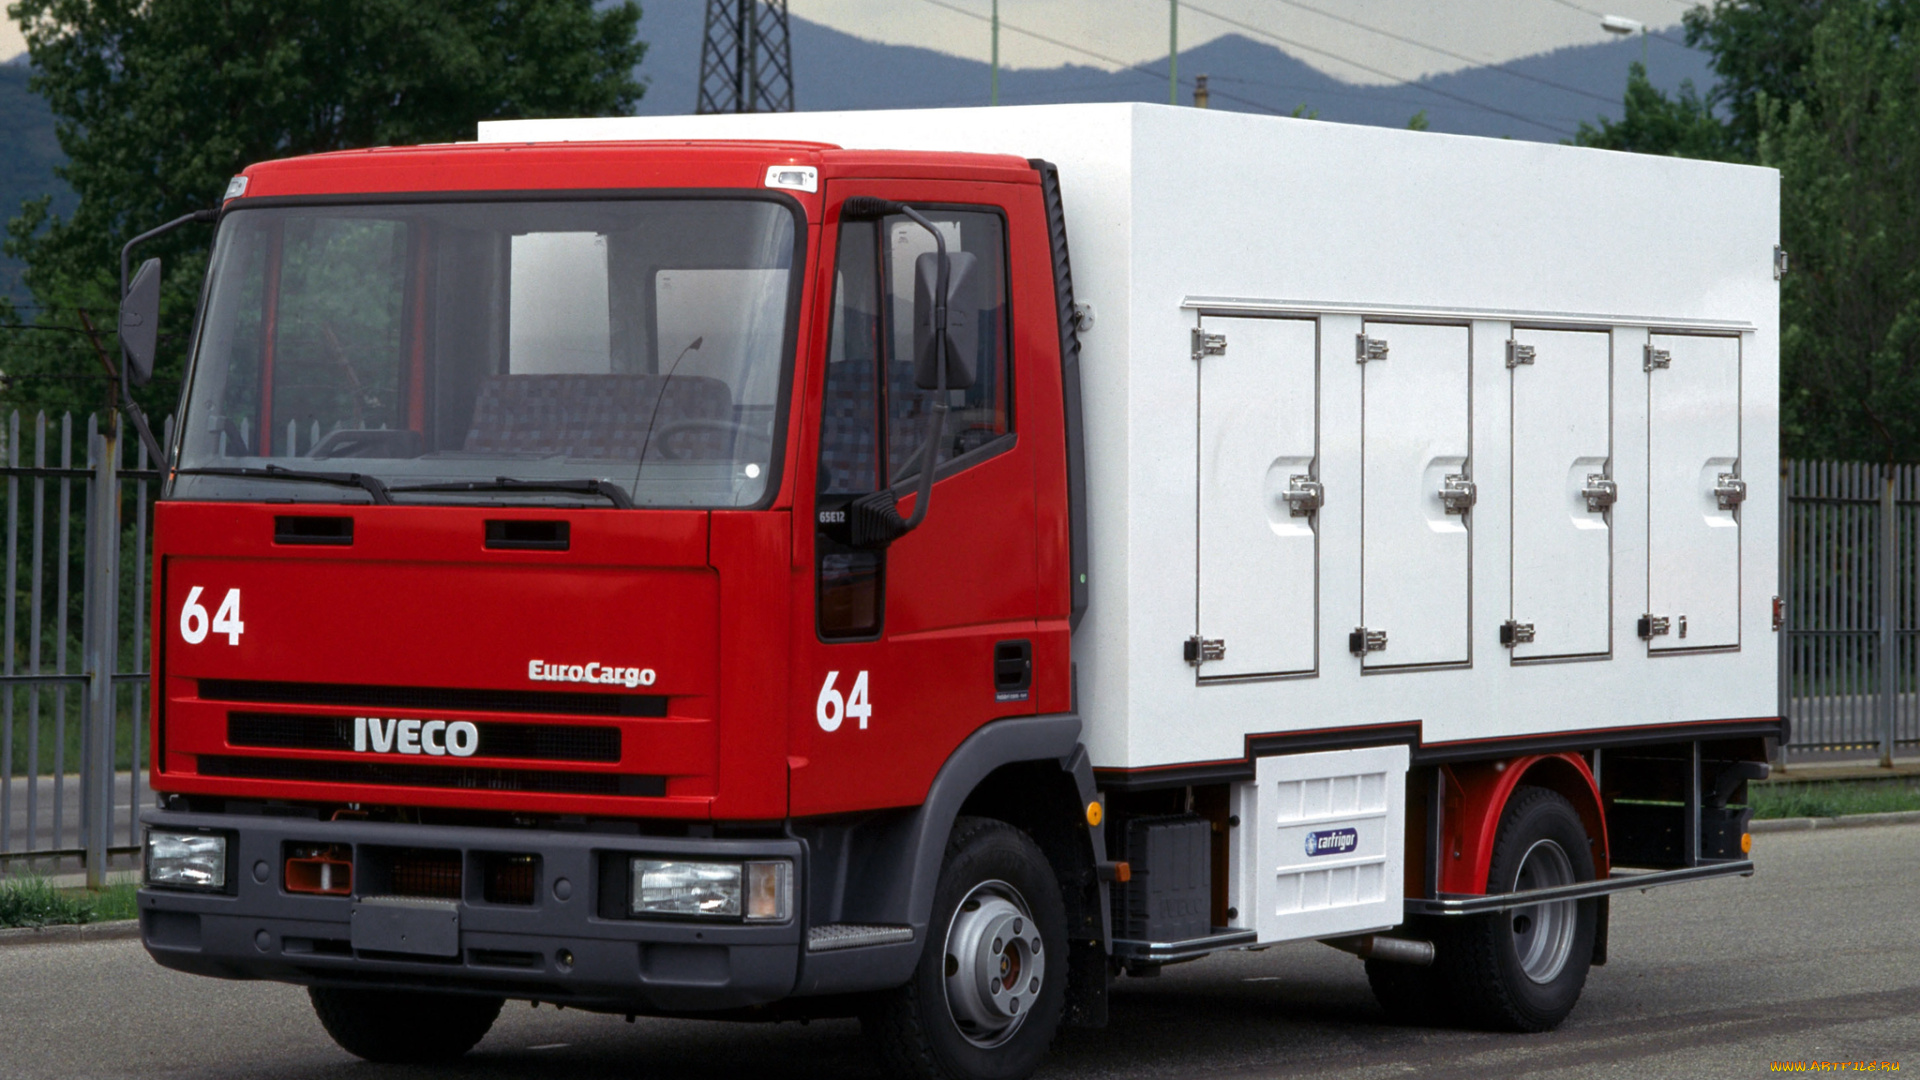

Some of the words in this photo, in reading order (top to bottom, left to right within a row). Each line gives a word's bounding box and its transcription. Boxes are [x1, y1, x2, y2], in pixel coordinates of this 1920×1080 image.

[819, 511, 846, 523] 65E12
[180, 586, 244, 646] 64
[528, 659, 656, 688] EuroCargo
[816, 670, 872, 733] 64
[354, 717, 478, 757] IVECO
[1318, 831, 1355, 851] carfrigor
